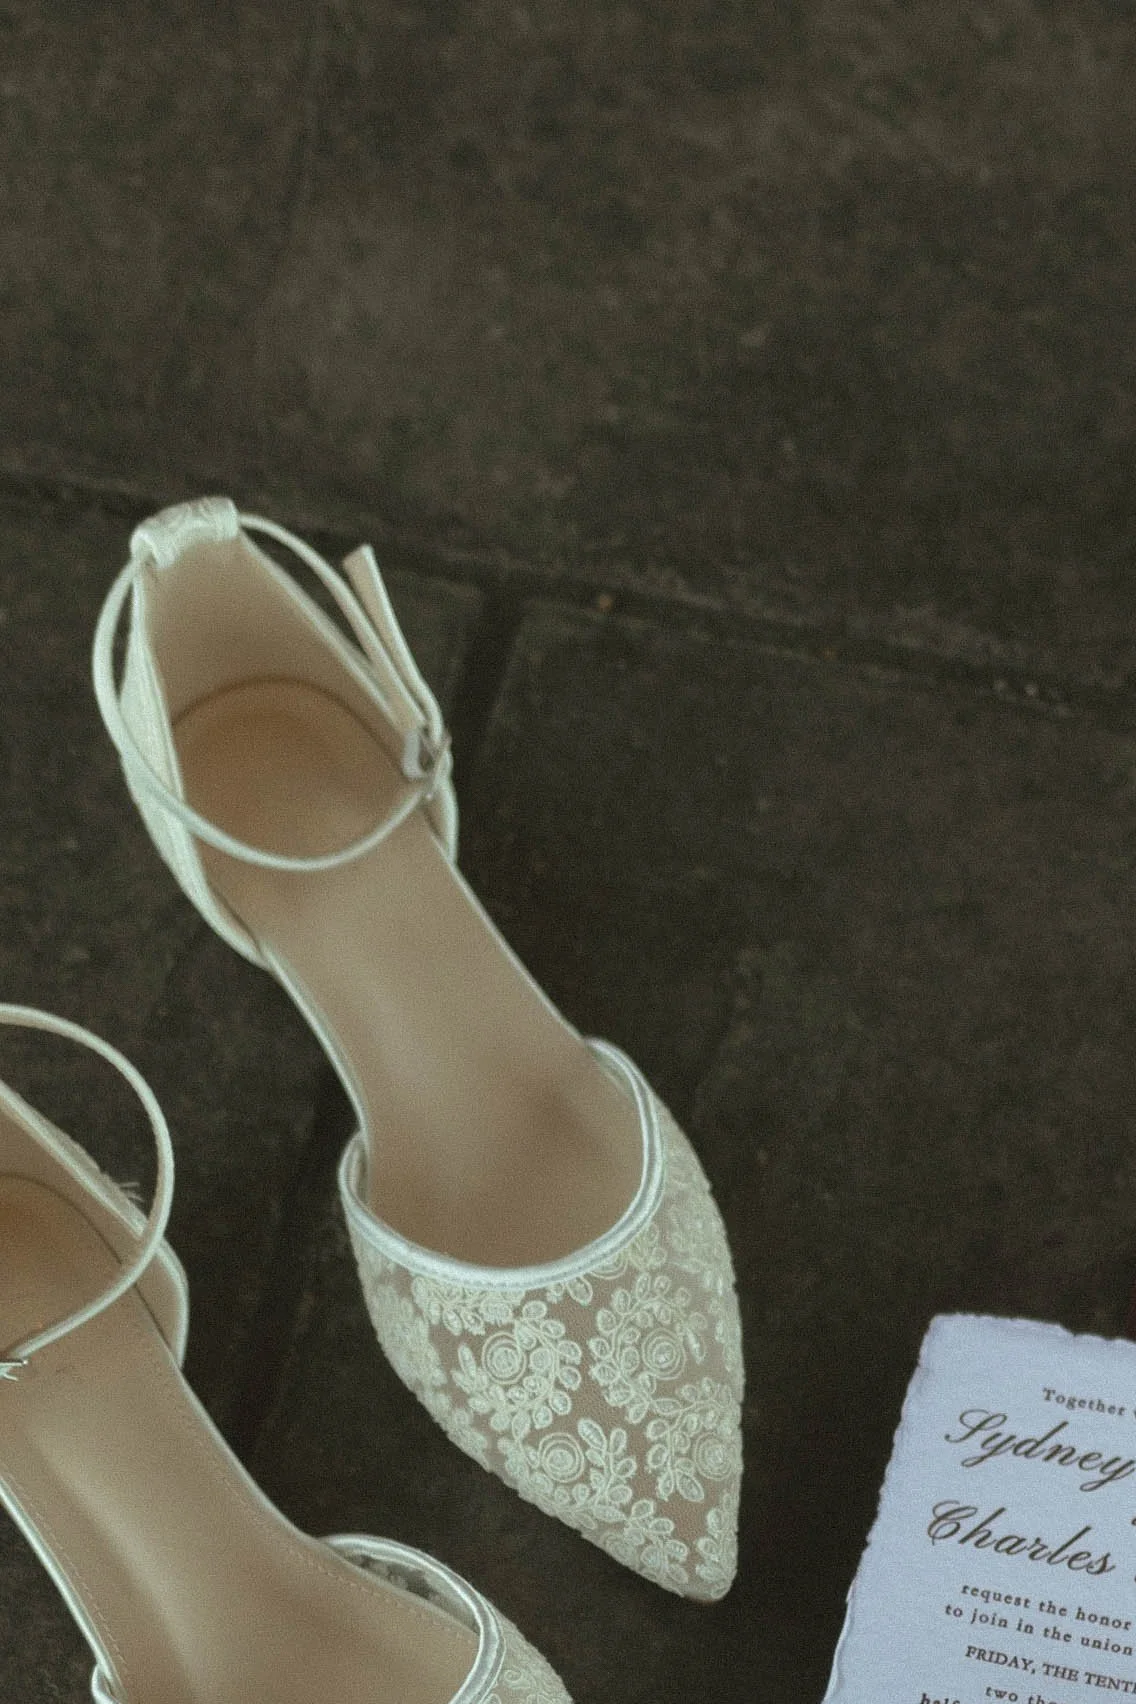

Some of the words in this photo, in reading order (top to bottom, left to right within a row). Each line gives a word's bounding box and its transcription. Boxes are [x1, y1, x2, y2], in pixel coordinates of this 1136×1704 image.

[1042, 1387, 1126, 1417] Together
[944, 1409, 1136, 1492] Sydney
[927, 1500, 1116, 1576] Charles
[945, 1604, 963, 1618] to
[970, 1608, 1008, 1629] join
[1016, 1618, 1034, 1635] in
[1043, 1626, 1072, 1643] the
[1080, 1637, 1133, 1656] union
[961, 1585, 1031, 1609] request
[1038, 1600, 1068, 1617] the
[1075, 1606, 1132, 1631] honor
[965, 1645, 1036, 1675] FRIDAY,
[1042, 1662, 1079, 1682] THE
[985, 1686, 1018, 1702] two
